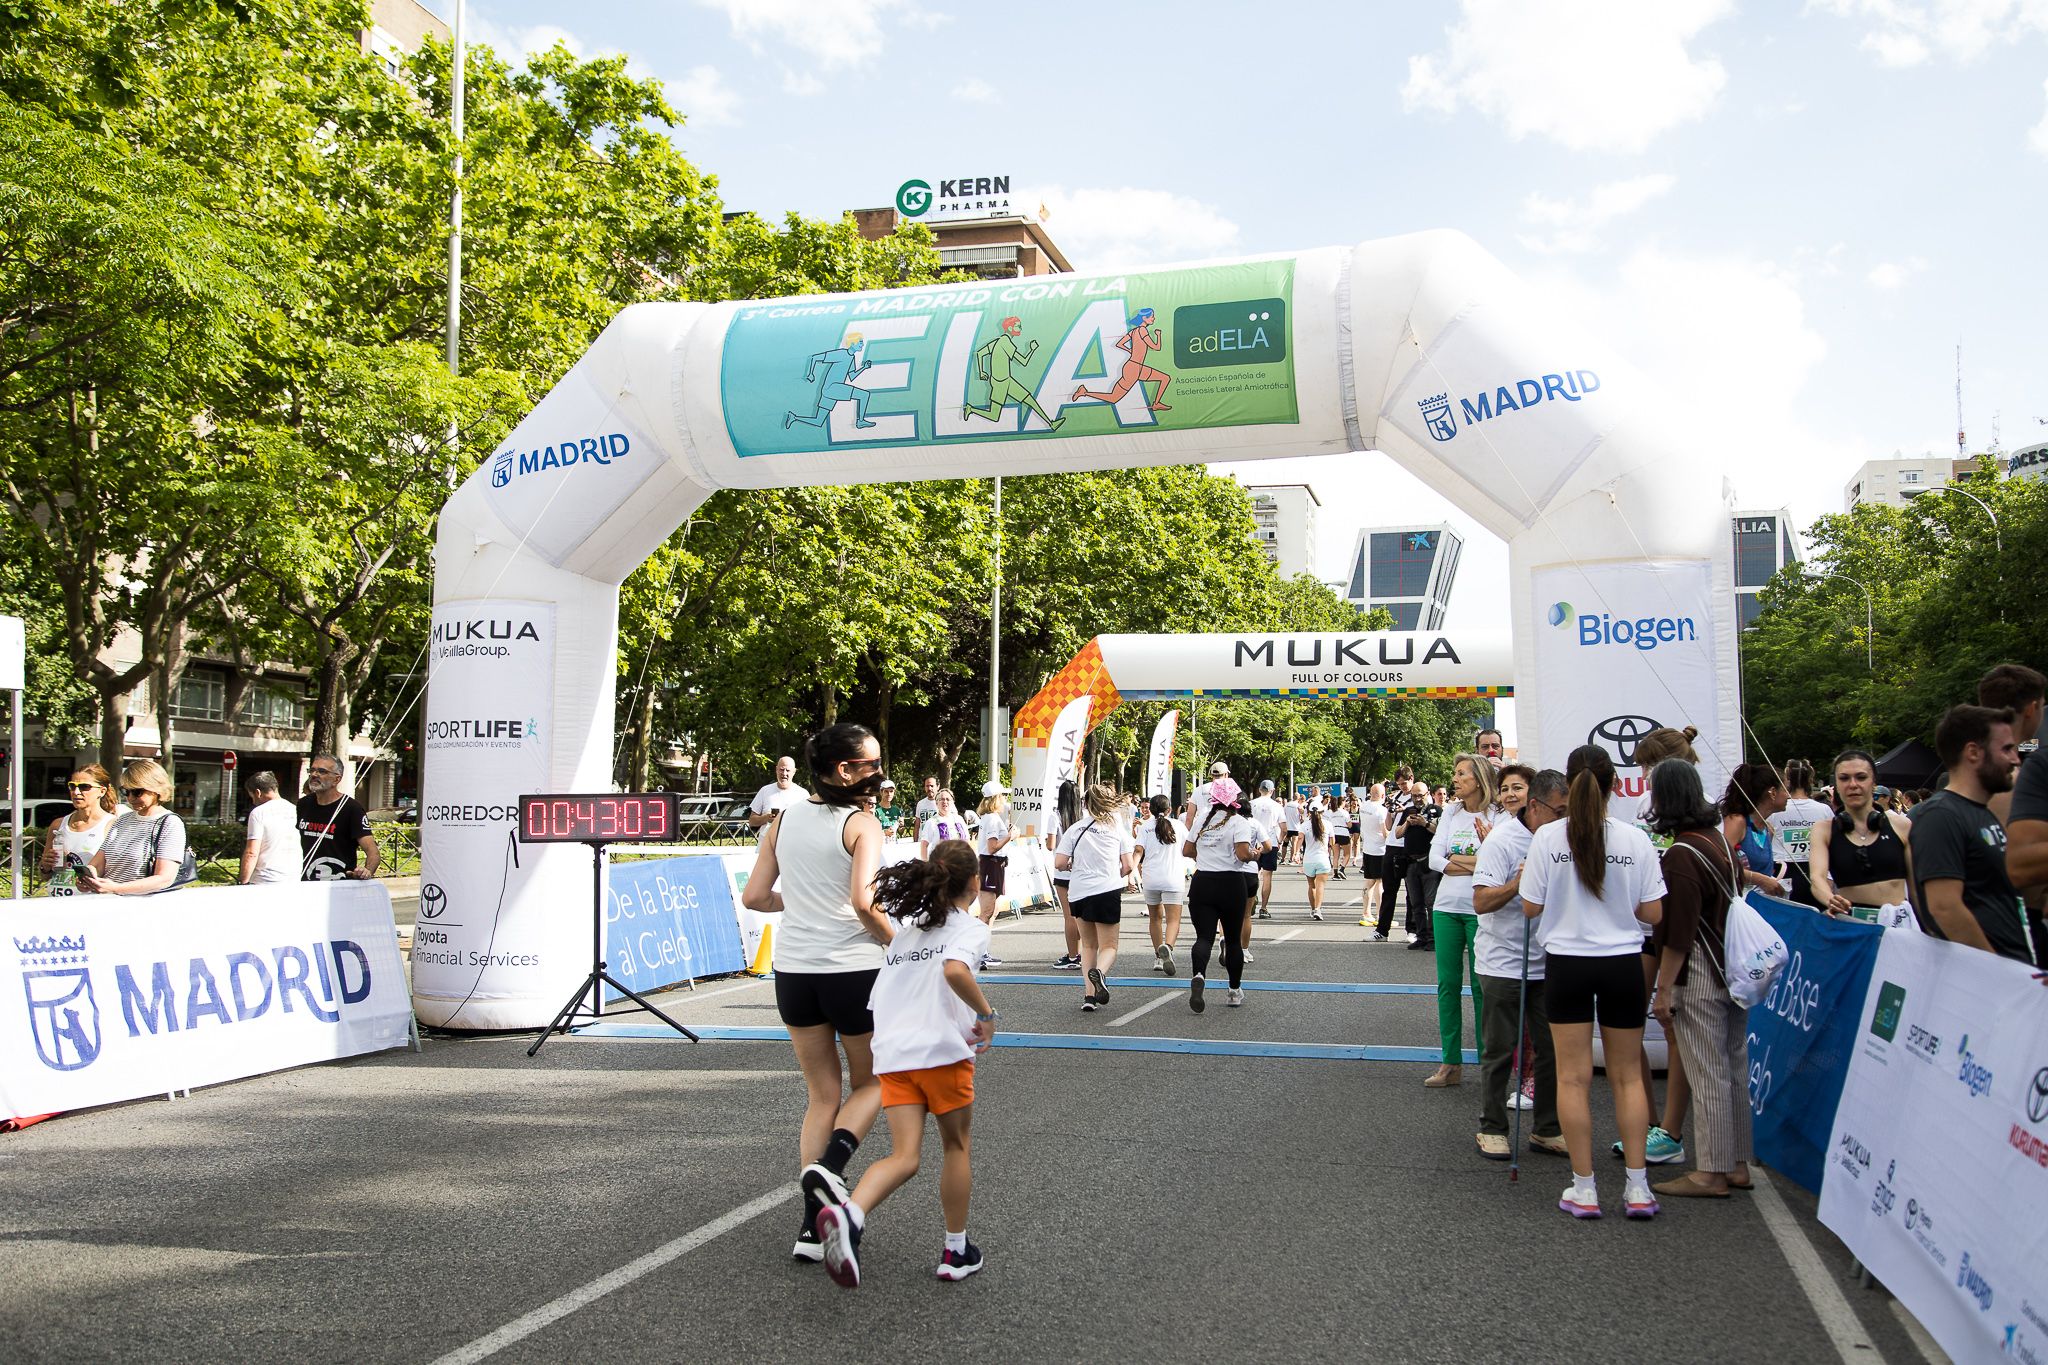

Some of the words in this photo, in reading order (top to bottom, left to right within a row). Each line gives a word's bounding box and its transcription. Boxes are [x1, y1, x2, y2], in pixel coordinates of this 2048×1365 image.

[940, 175, 1010, 197] KERN
[940, 200, 1009, 211] PHARMA
[768, 304, 846, 319] Carrera
[852, 290, 995, 316] MADRID
[1000, 282, 1077, 302] CON
[1082, 277, 1127, 295] LA
[828, 297, 1157, 444] ELA
[1175, 374, 1217, 384] Asociación
[1218, 372, 1254, 382] Española
[1255, 371, 1266, 379] de
[1176, 387, 1215, 396] Esclerosis
[1216, 384, 1242, 392] Lateral
[1244, 381, 1289, 391] Amiotrófica
[1459, 369, 1601, 425] MADRID
[519, 433, 630, 475] MADRID
[432, 620, 540, 644] MUKUA
[1578, 613, 1696, 650] Biogen
[1234, 637, 1462, 667] MUKUA
[1292, 673, 1320, 683] FULL
[1324, 673, 1340, 683] OF
[1343, 672, 1403, 683] COLOURS
[427, 720, 523, 740] SPORTLIFE
[1014, 788, 1025, 797] DA
[426, 805, 519, 821] CORREDOR
[529, 801, 665, 836] 00:43:03
[1013, 802, 1027, 811] TUS
[608, 888, 636, 923] De
[634, 880, 658, 916] la
[418, 927, 447, 946] Toyota
[416, 947, 463, 966] Financial
[469, 951, 539, 967] Services
[618, 936, 638, 976] al
[639, 927, 692, 969] Cielo
[114, 939, 371, 1037] MADRID
[1959, 1051, 1993, 1097] Biogen
[1841, 1132, 1871, 1170] MUKUA
